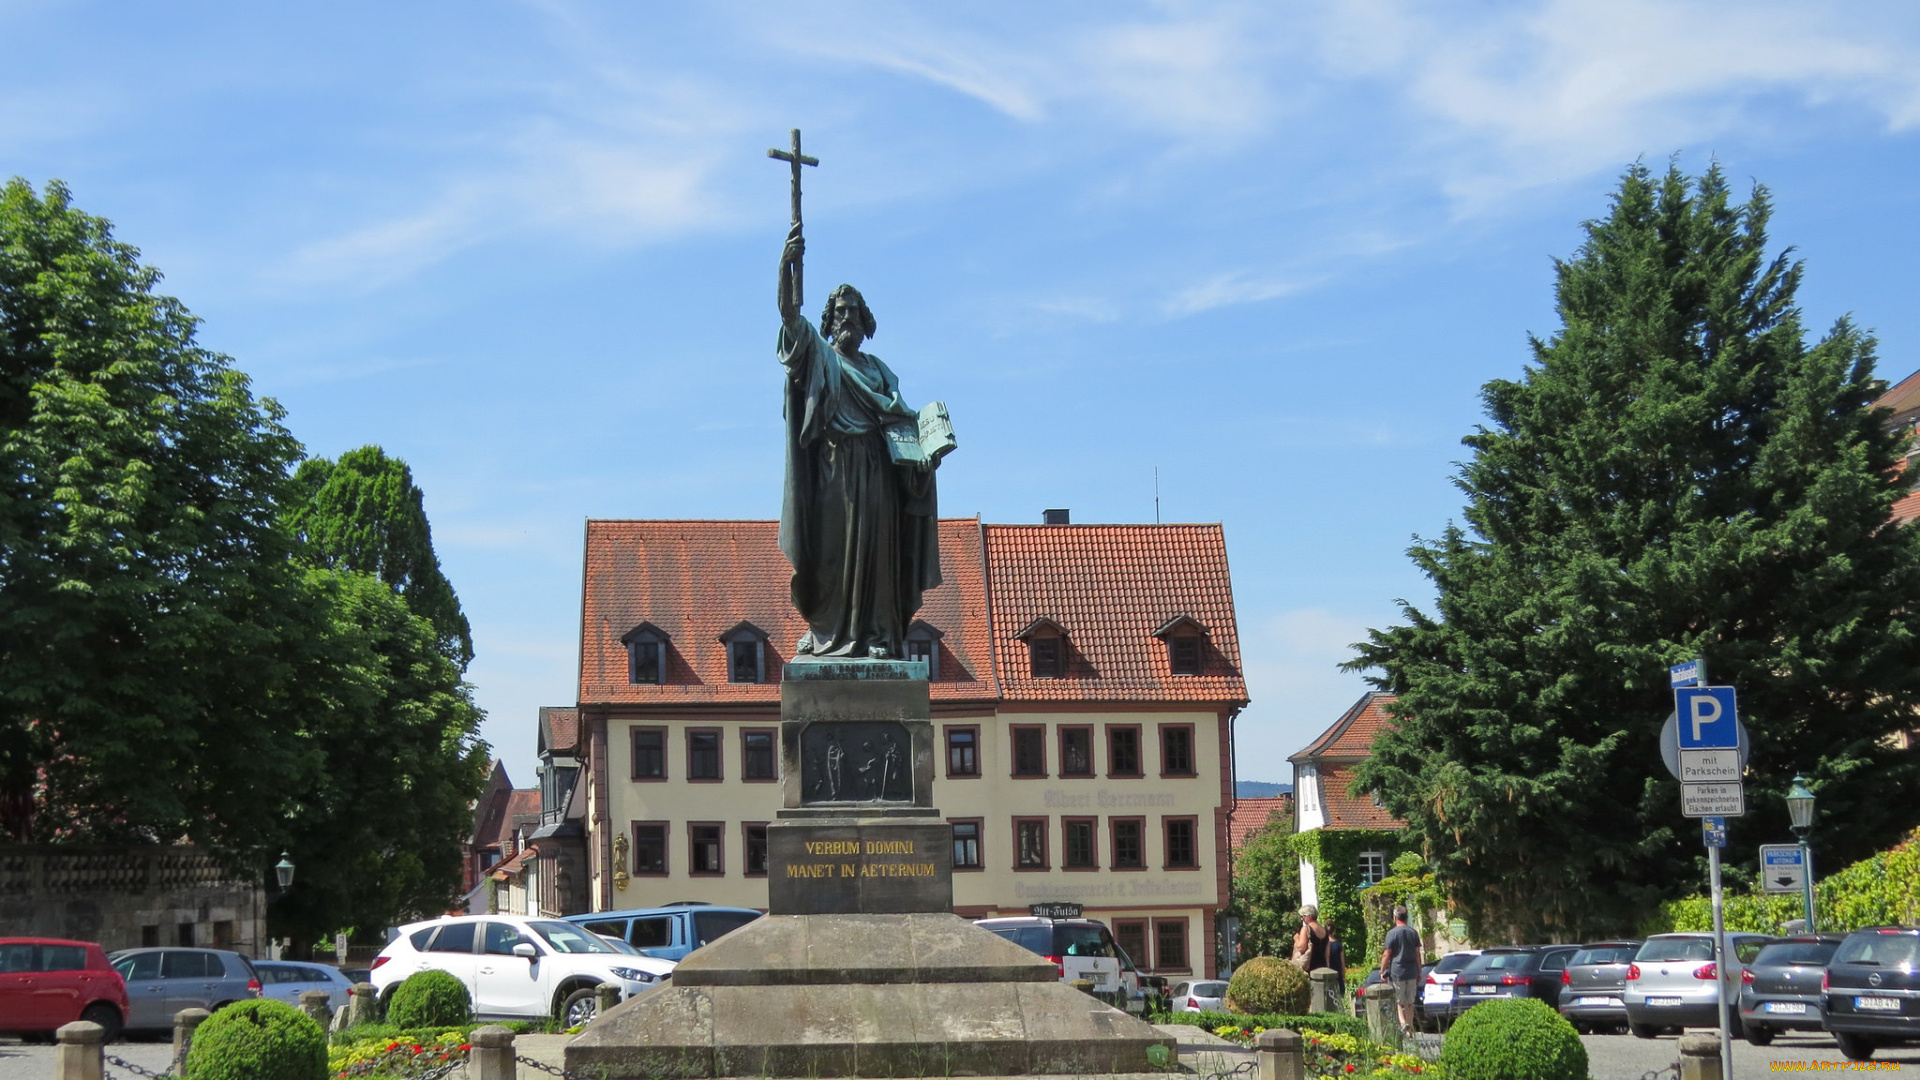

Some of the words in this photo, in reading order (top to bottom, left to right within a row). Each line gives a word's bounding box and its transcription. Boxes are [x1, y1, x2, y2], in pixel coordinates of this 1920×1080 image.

[1691, 695, 1722, 741] P
[1702, 756, 1717, 765] mit
[1685, 766, 1736, 776] Parkschein
[1697, 786, 1719, 795] Parken
[1720, 786, 1727, 794] in
[1686, 796, 1739, 805] gekennzeichneten
[1715, 804, 1737, 812] erlaubt
[804, 841, 860, 855] VERBUM
[867, 840, 915, 854] DOMINI
[787, 864, 835, 878] MANET
[841, 864, 855, 878] IN
[861, 864, 935, 878] AETERNUM
[1034, 905, 1078, 916] Alt-Fulda
